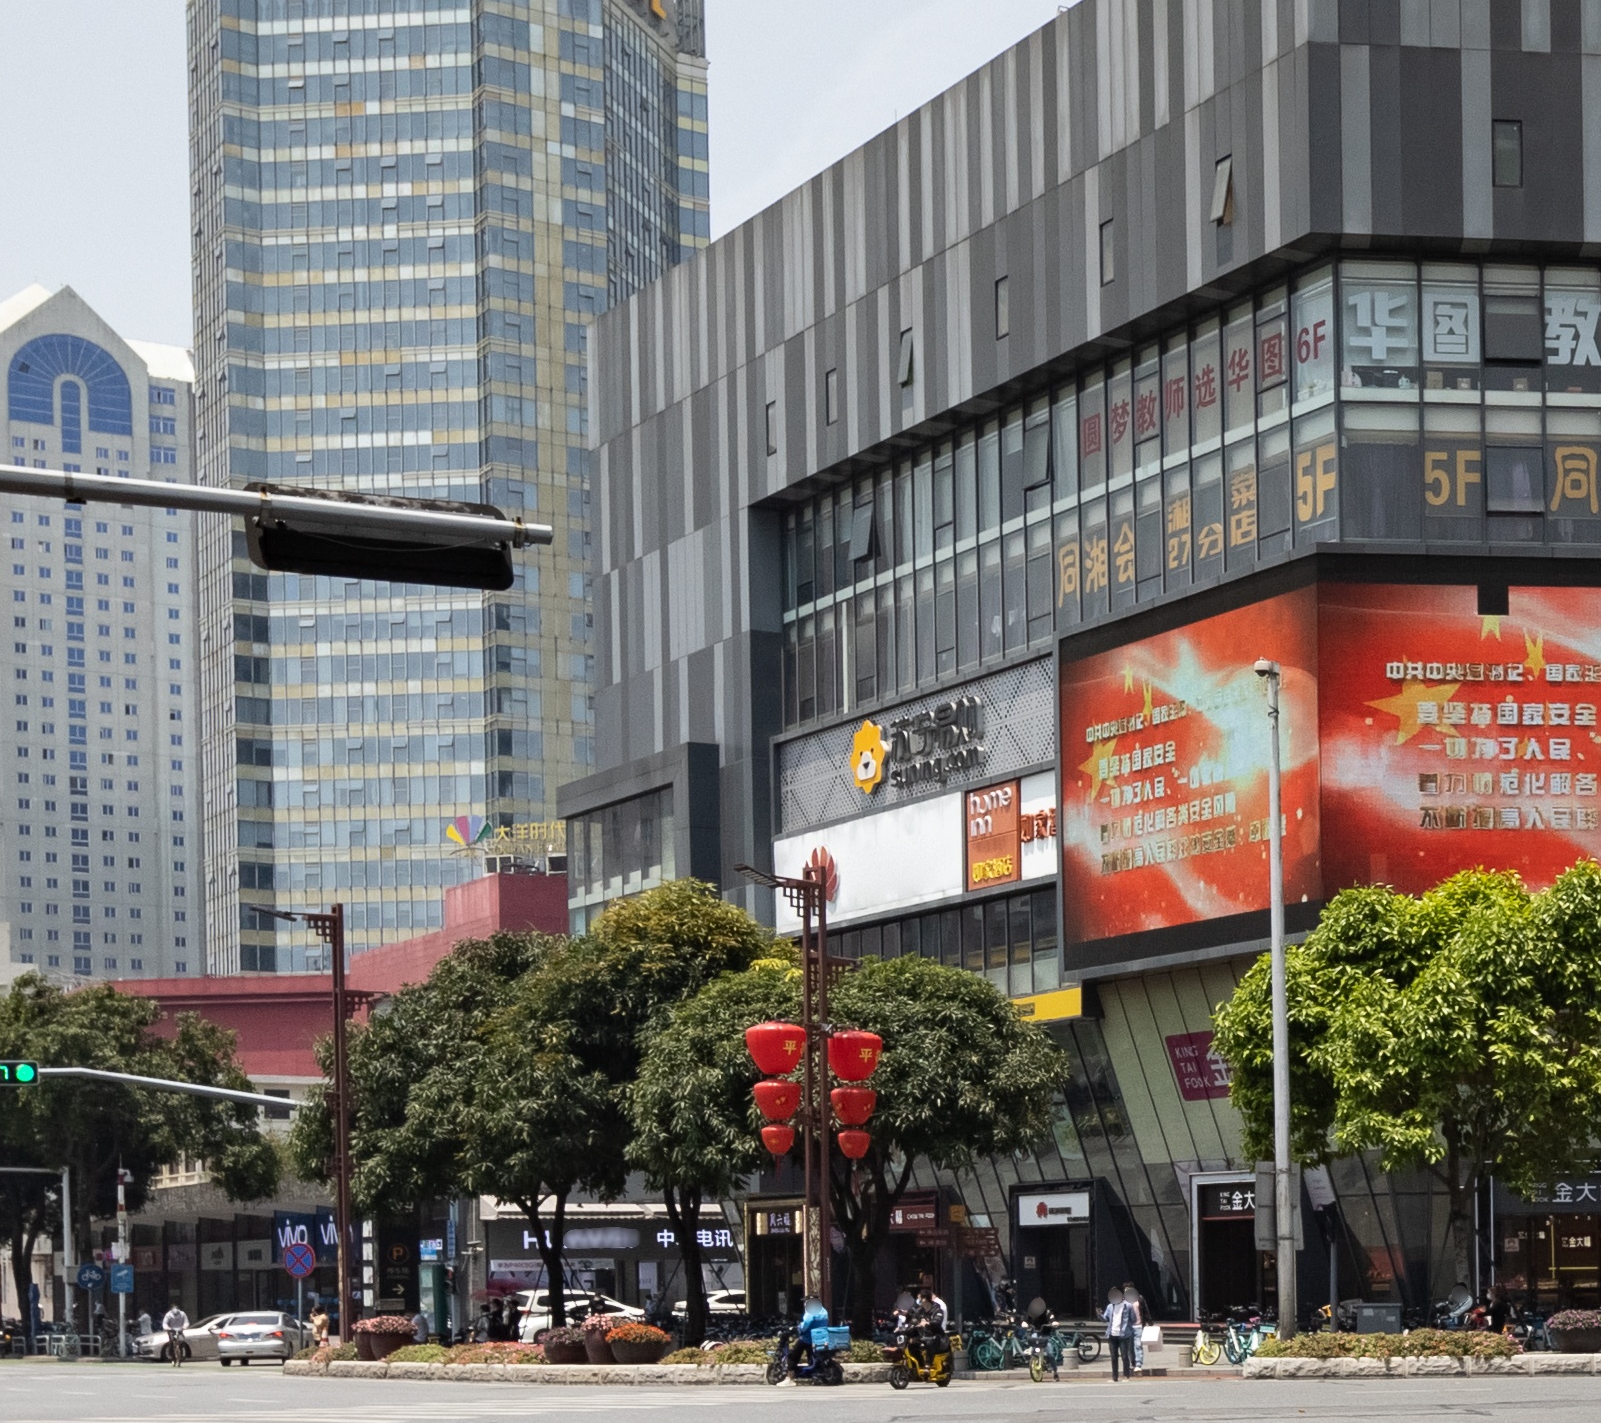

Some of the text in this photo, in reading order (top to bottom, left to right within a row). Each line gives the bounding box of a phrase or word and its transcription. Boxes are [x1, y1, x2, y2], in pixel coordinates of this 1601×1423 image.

[1297, 319, 1326, 364] 6F
[1297, 443, 1337, 522] 5F
[1425, 449, 1482, 507] 5F
[1059, 522, 1135, 607] 同湘会
[1417, 701, 1597, 726] 要坚持国家安全
[969, 786, 1012, 815] home
[1180, 1062, 1197, 1074] TAI
[1184, 1075, 1211, 1089] FOOK
[277, 1219, 308, 1249] vivo
[656, 1228, 734, 1249] 中电讯
